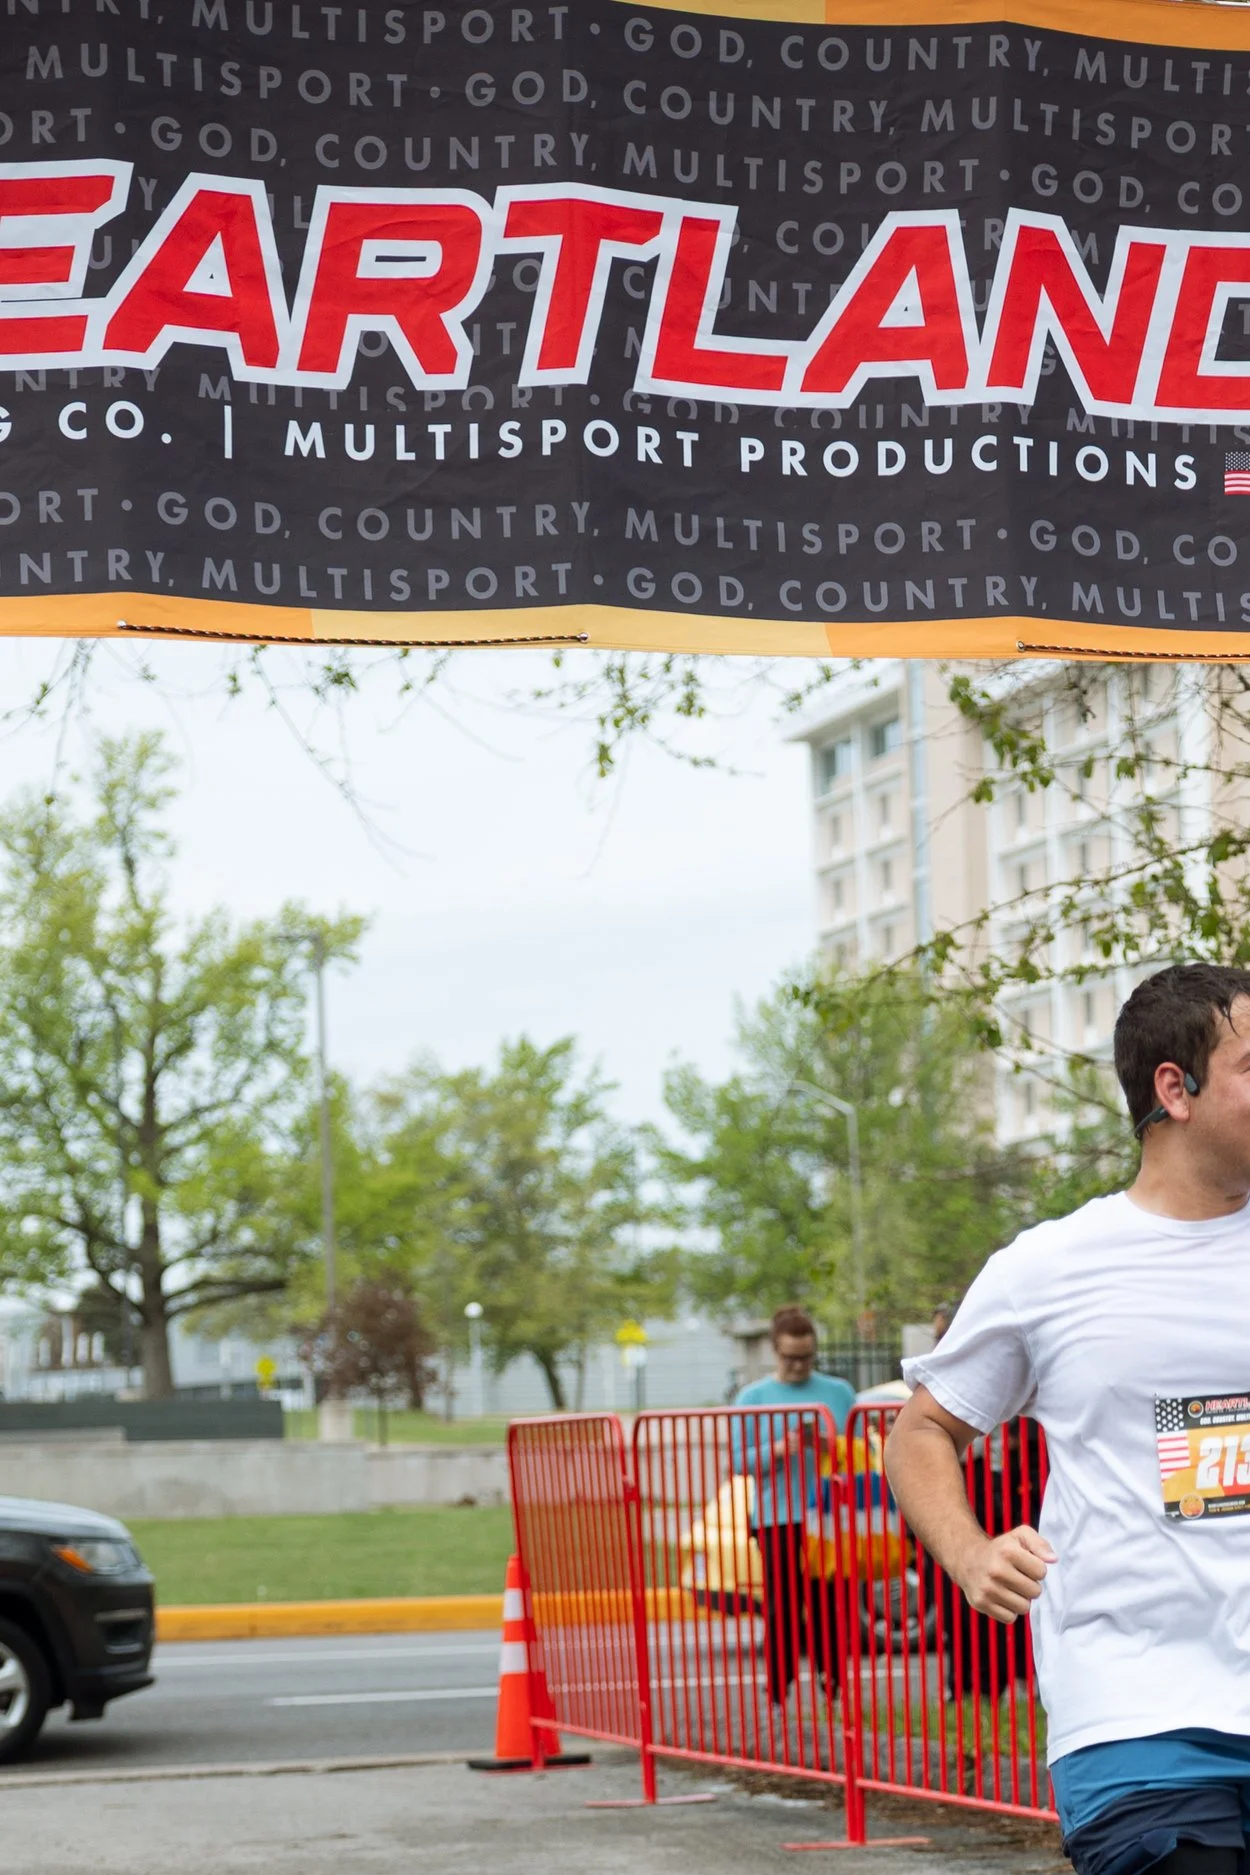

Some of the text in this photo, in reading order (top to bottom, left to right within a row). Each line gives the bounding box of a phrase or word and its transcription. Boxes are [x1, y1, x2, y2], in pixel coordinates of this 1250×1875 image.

[191, 0, 568, 44] MULTISPORT
[624, 17, 752, 68] GOD,
[780, 34, 1049, 77] COUNTRY,
[26, 43, 407, 107] MULTISPORT
[465, 69, 597, 109] GOD,
[623, 80, 895, 136] COUNTRY,
[151, 116, 287, 167] GOD,
[315, 132, 597, 171] COUNTRY,
[623, 142, 979, 195] MULTISPORT
[1031, 163, 1150, 213] GOD,
[58, 400, 172, 445] CO.
[284, 418, 699, 468] MULTISPORT
[740, 434, 1197, 491] PRODUCTIONS
[157, 491, 290, 538] GOD,
[318, 501, 599, 541] COUNTRY,
[624, 507, 977, 554] MULTISPORT
[1029, 519, 1149, 565] GOD,
[201, 557, 572, 602] MULTISPORT
[627, 566, 754, 613] GOD,
[780, 575, 1047, 613] COUNTRY,
